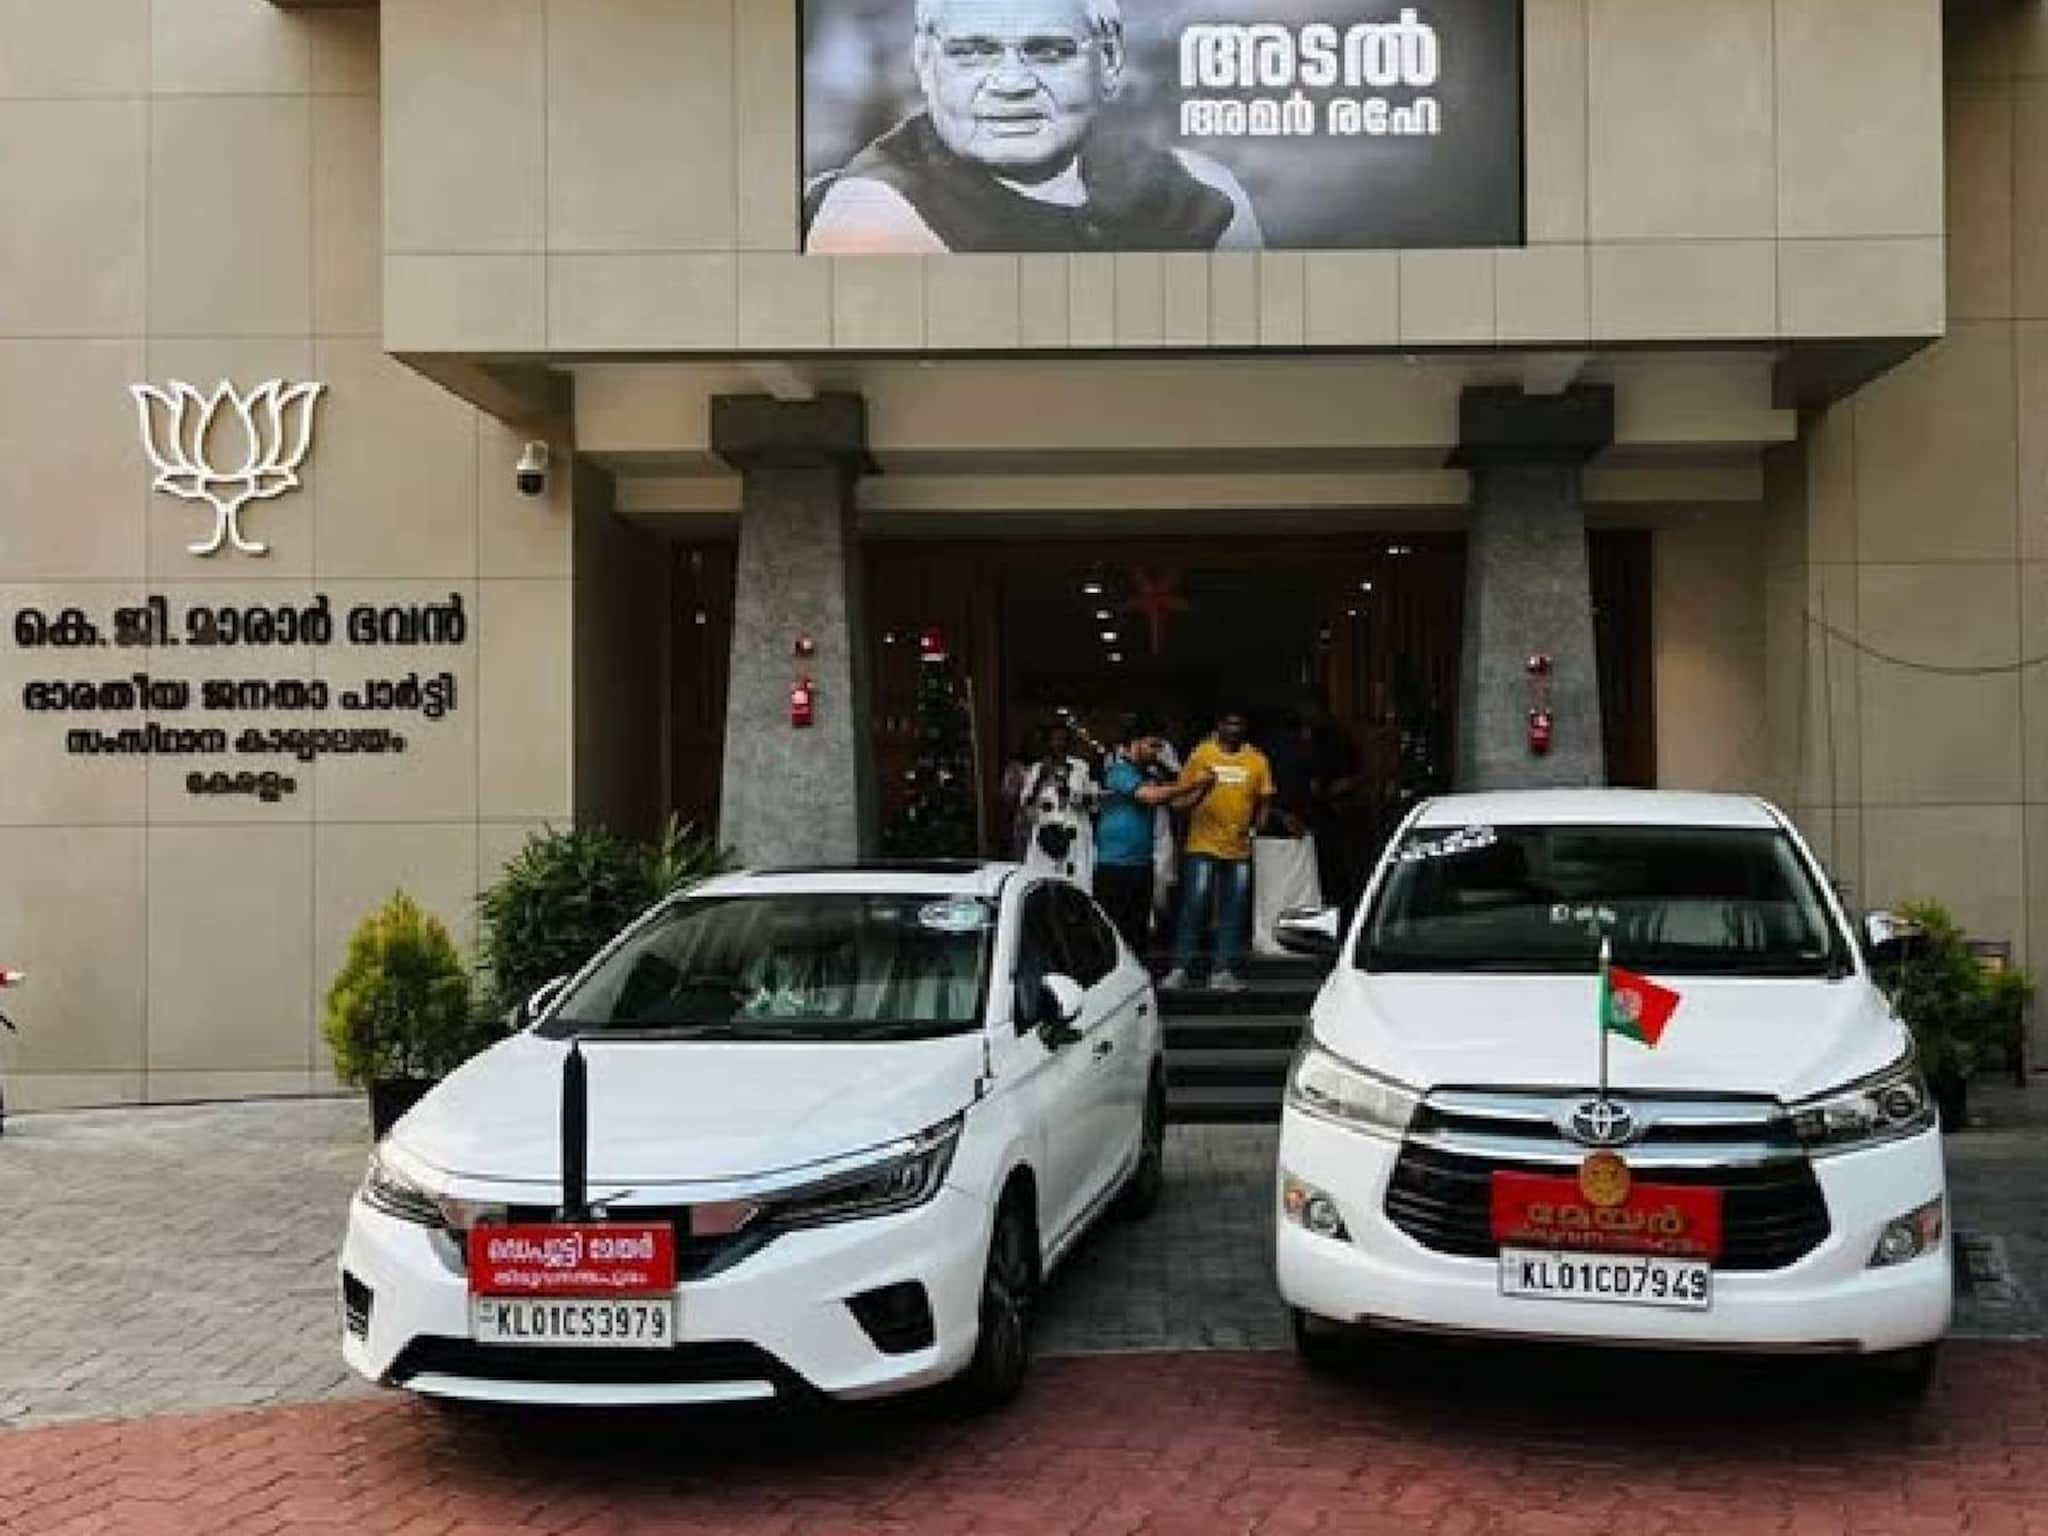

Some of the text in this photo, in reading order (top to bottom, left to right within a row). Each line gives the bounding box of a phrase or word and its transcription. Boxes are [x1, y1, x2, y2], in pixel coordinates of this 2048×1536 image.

[1180, 7, 1440, 87] അടൽ
[1180, 88, 1440, 136] അമർ രഹേ
[347, 592, 466, 646] ഭവൻ
[23, 672, 458, 719] ഭാരതീയ ജനതാ പാർട്ടി
[1523, 1263, 1706, 1299] KL01CD7949
[498, 1306, 665, 1337] KL01CS3979
